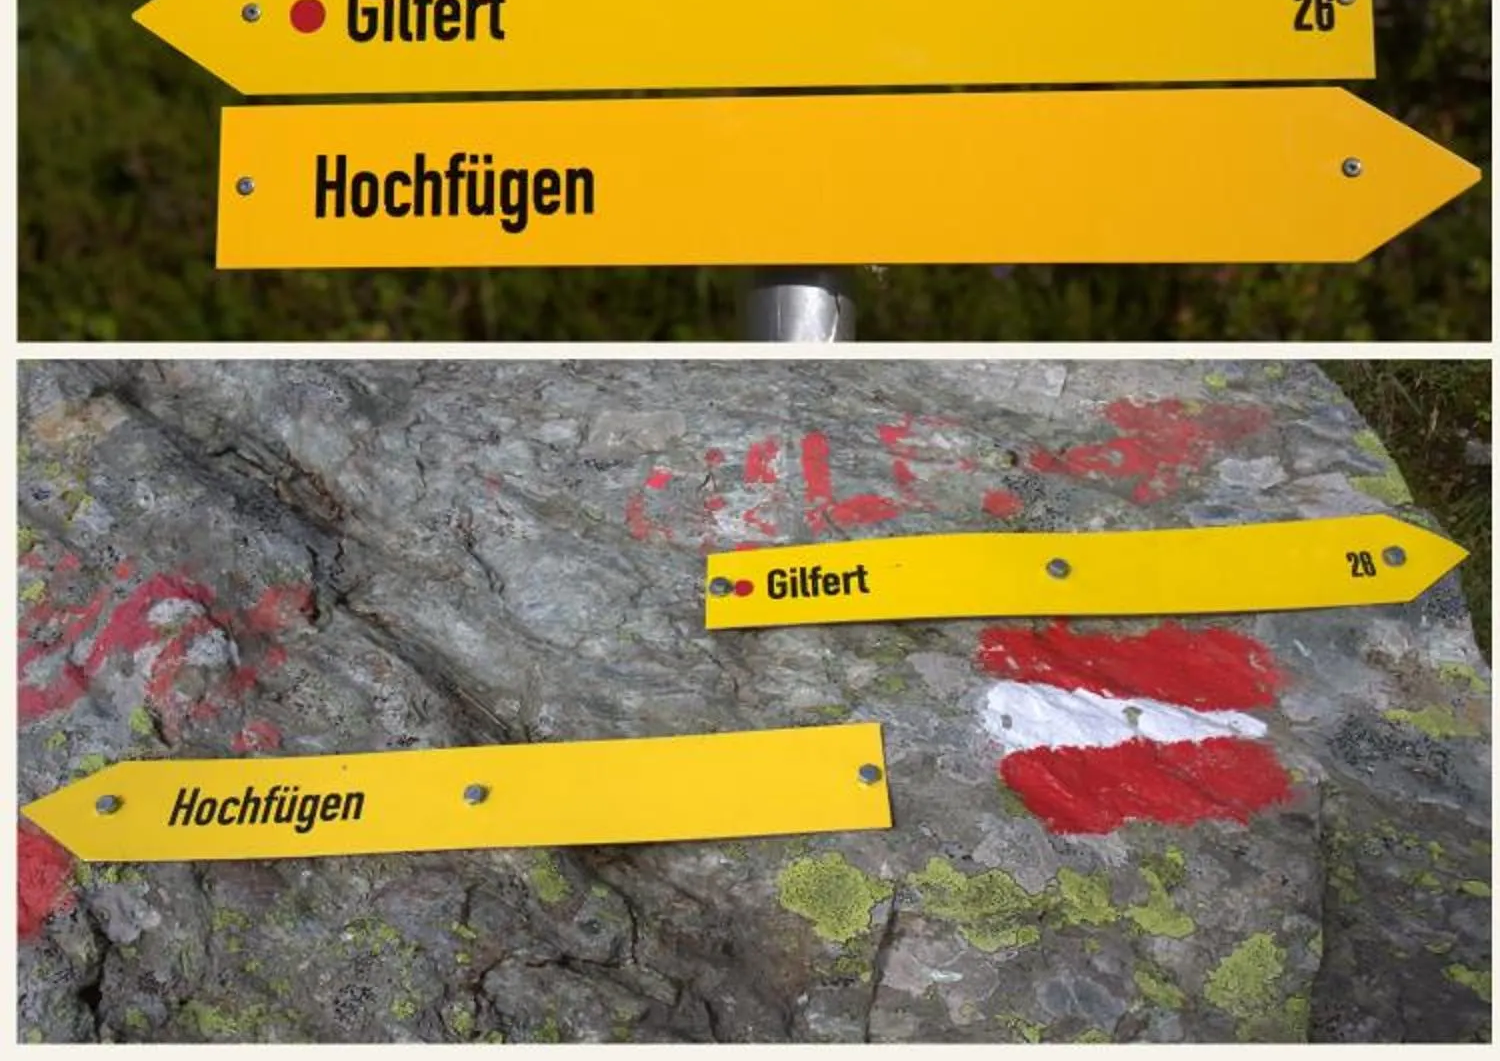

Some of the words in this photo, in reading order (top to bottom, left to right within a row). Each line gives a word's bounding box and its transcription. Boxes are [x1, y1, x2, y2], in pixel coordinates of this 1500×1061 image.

[315, 152, 595, 233] Hochfügen
[767, 564, 870, 600] Gilfert
[168, 785, 365, 834] Hochfügen
